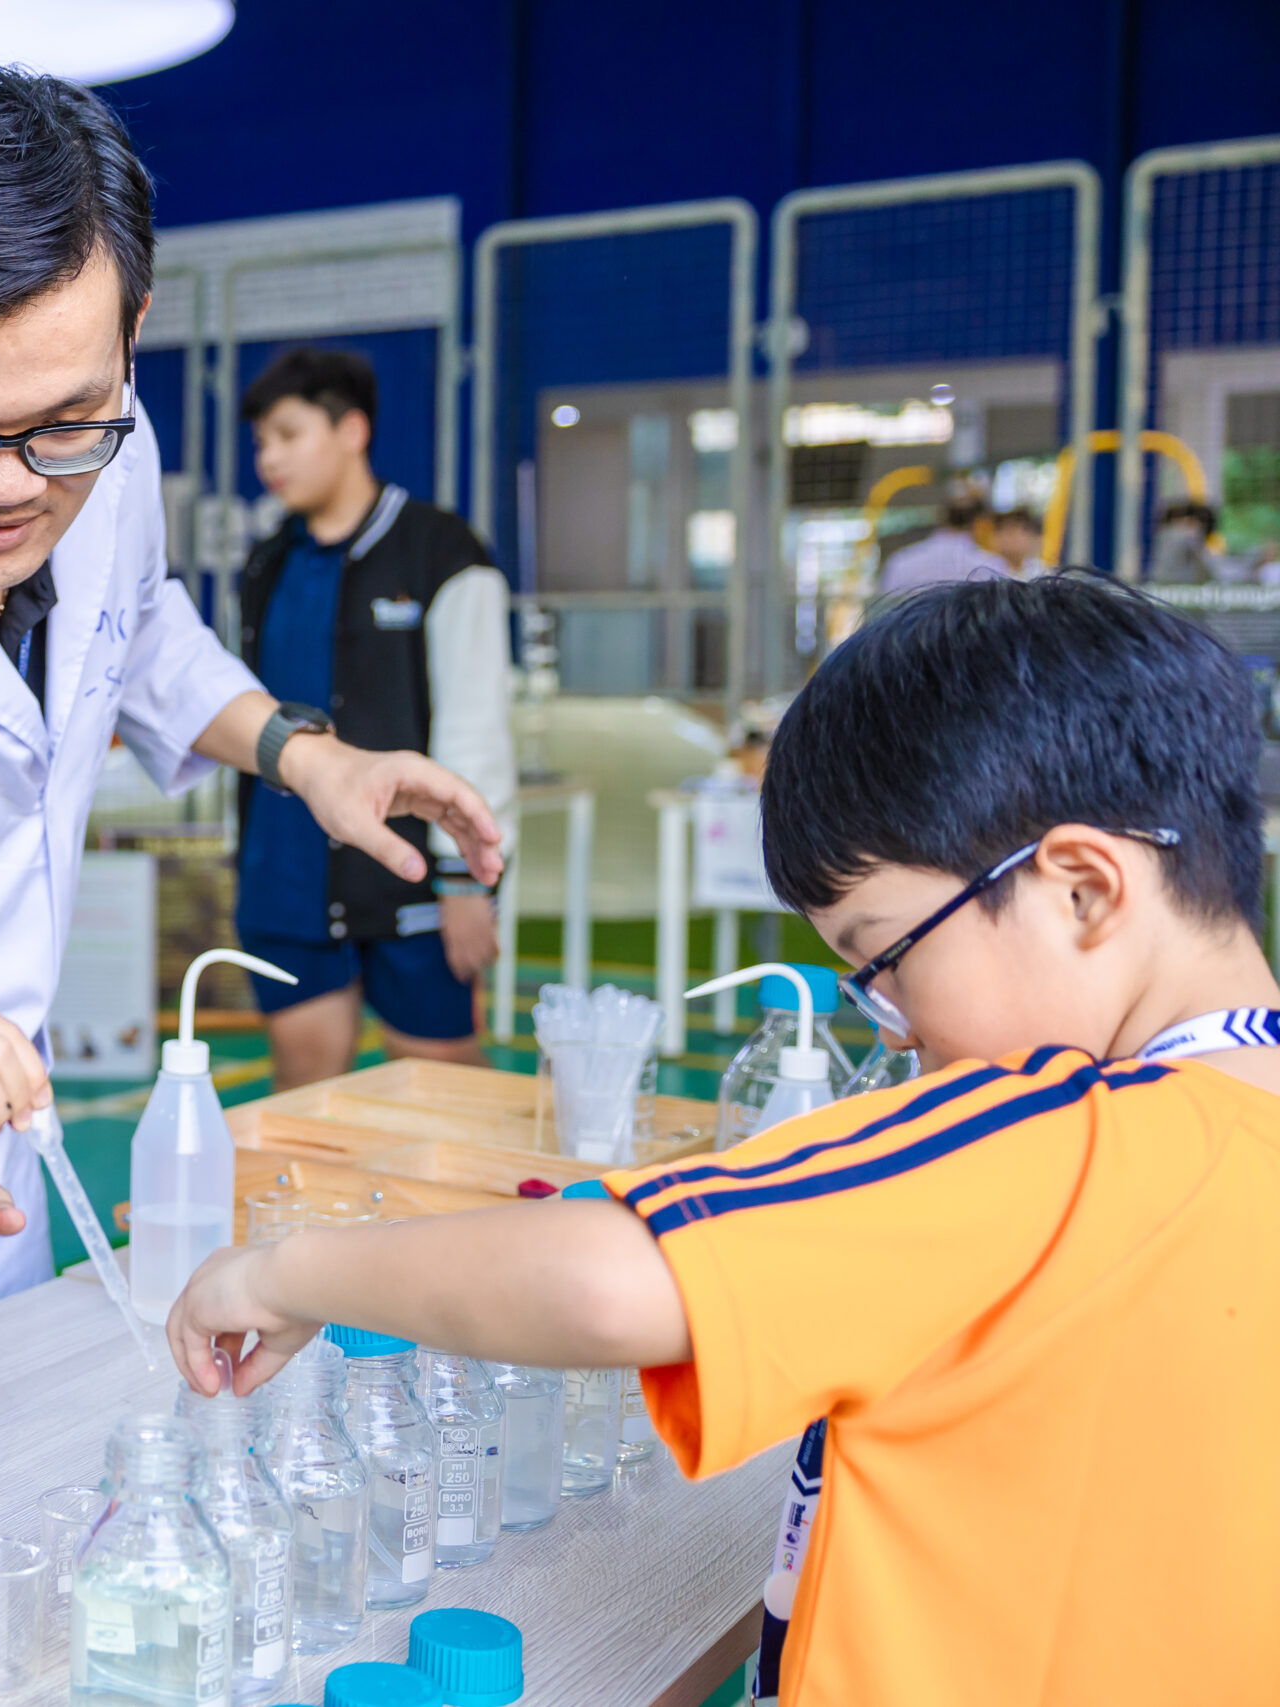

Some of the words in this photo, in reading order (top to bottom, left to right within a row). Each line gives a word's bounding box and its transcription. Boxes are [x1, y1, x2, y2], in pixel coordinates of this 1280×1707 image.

[451, 1461, 467, 1471] ml
[446, 1472, 470, 1484] 250
[414, 1493, 426, 1505] ml
[442, 1493, 472, 1503] BORO
[410, 1506, 428, 1519] 250
[450, 1504, 464, 1512] 3.3
[407, 1525, 429, 1539] BORO
[412, 1537, 424, 1548] 3.3
